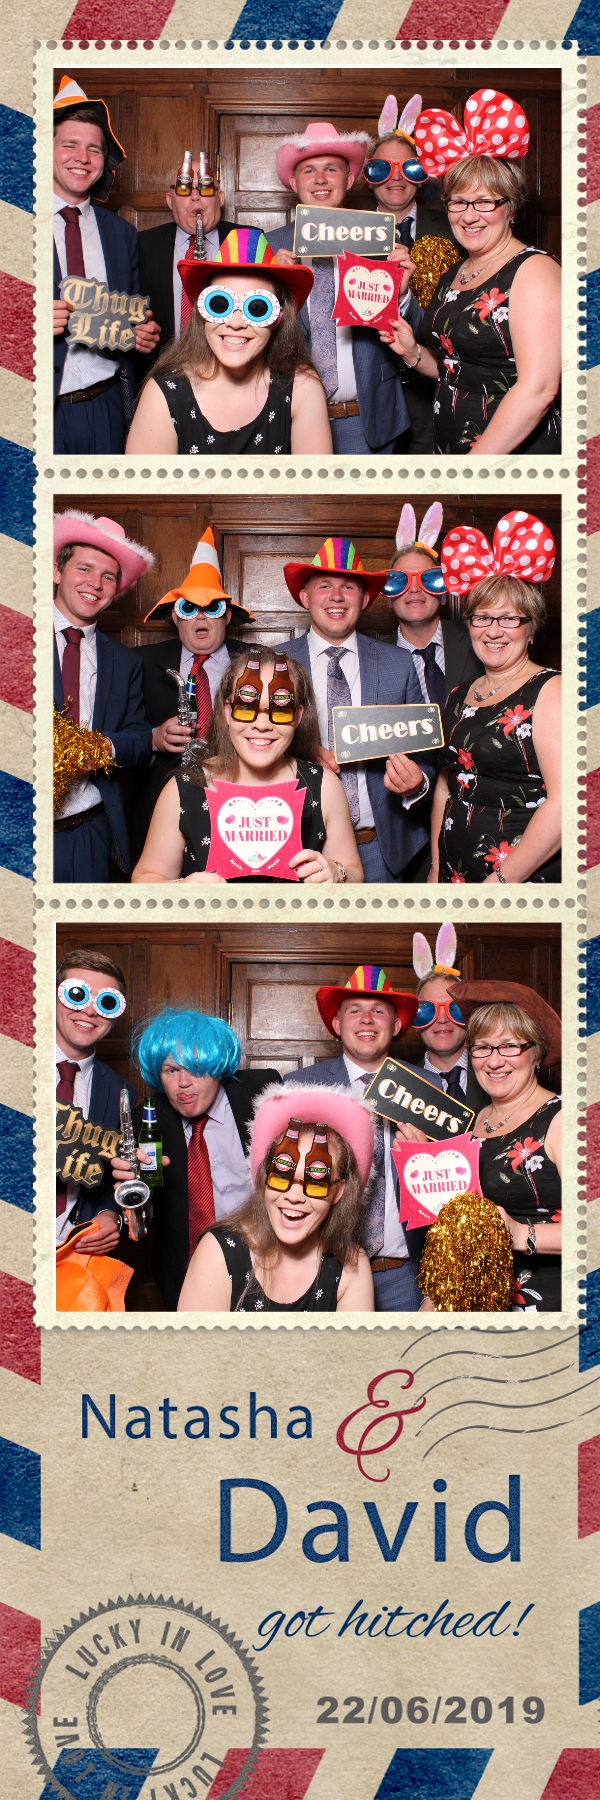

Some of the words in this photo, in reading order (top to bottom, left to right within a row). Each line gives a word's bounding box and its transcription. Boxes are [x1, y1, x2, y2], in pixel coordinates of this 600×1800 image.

[301, 222, 388, 242] Cheers
[357, 280, 380, 292] JUST
[62, 278, 148, 323] Thug
[347, 289, 390, 304] MARRIED
[69, 312, 134, 349] Life
[341, 717, 434, 746] Cheers
[238, 816, 272, 828] JUST
[224, 830, 288, 842] MARRIED
[377, 1078, 463, 1134] Cheers
[56, 1149, 103, 1186] ife
[422, 1169, 451, 1181] JUST
[411, 1180, 467, 1194] MARRIED
